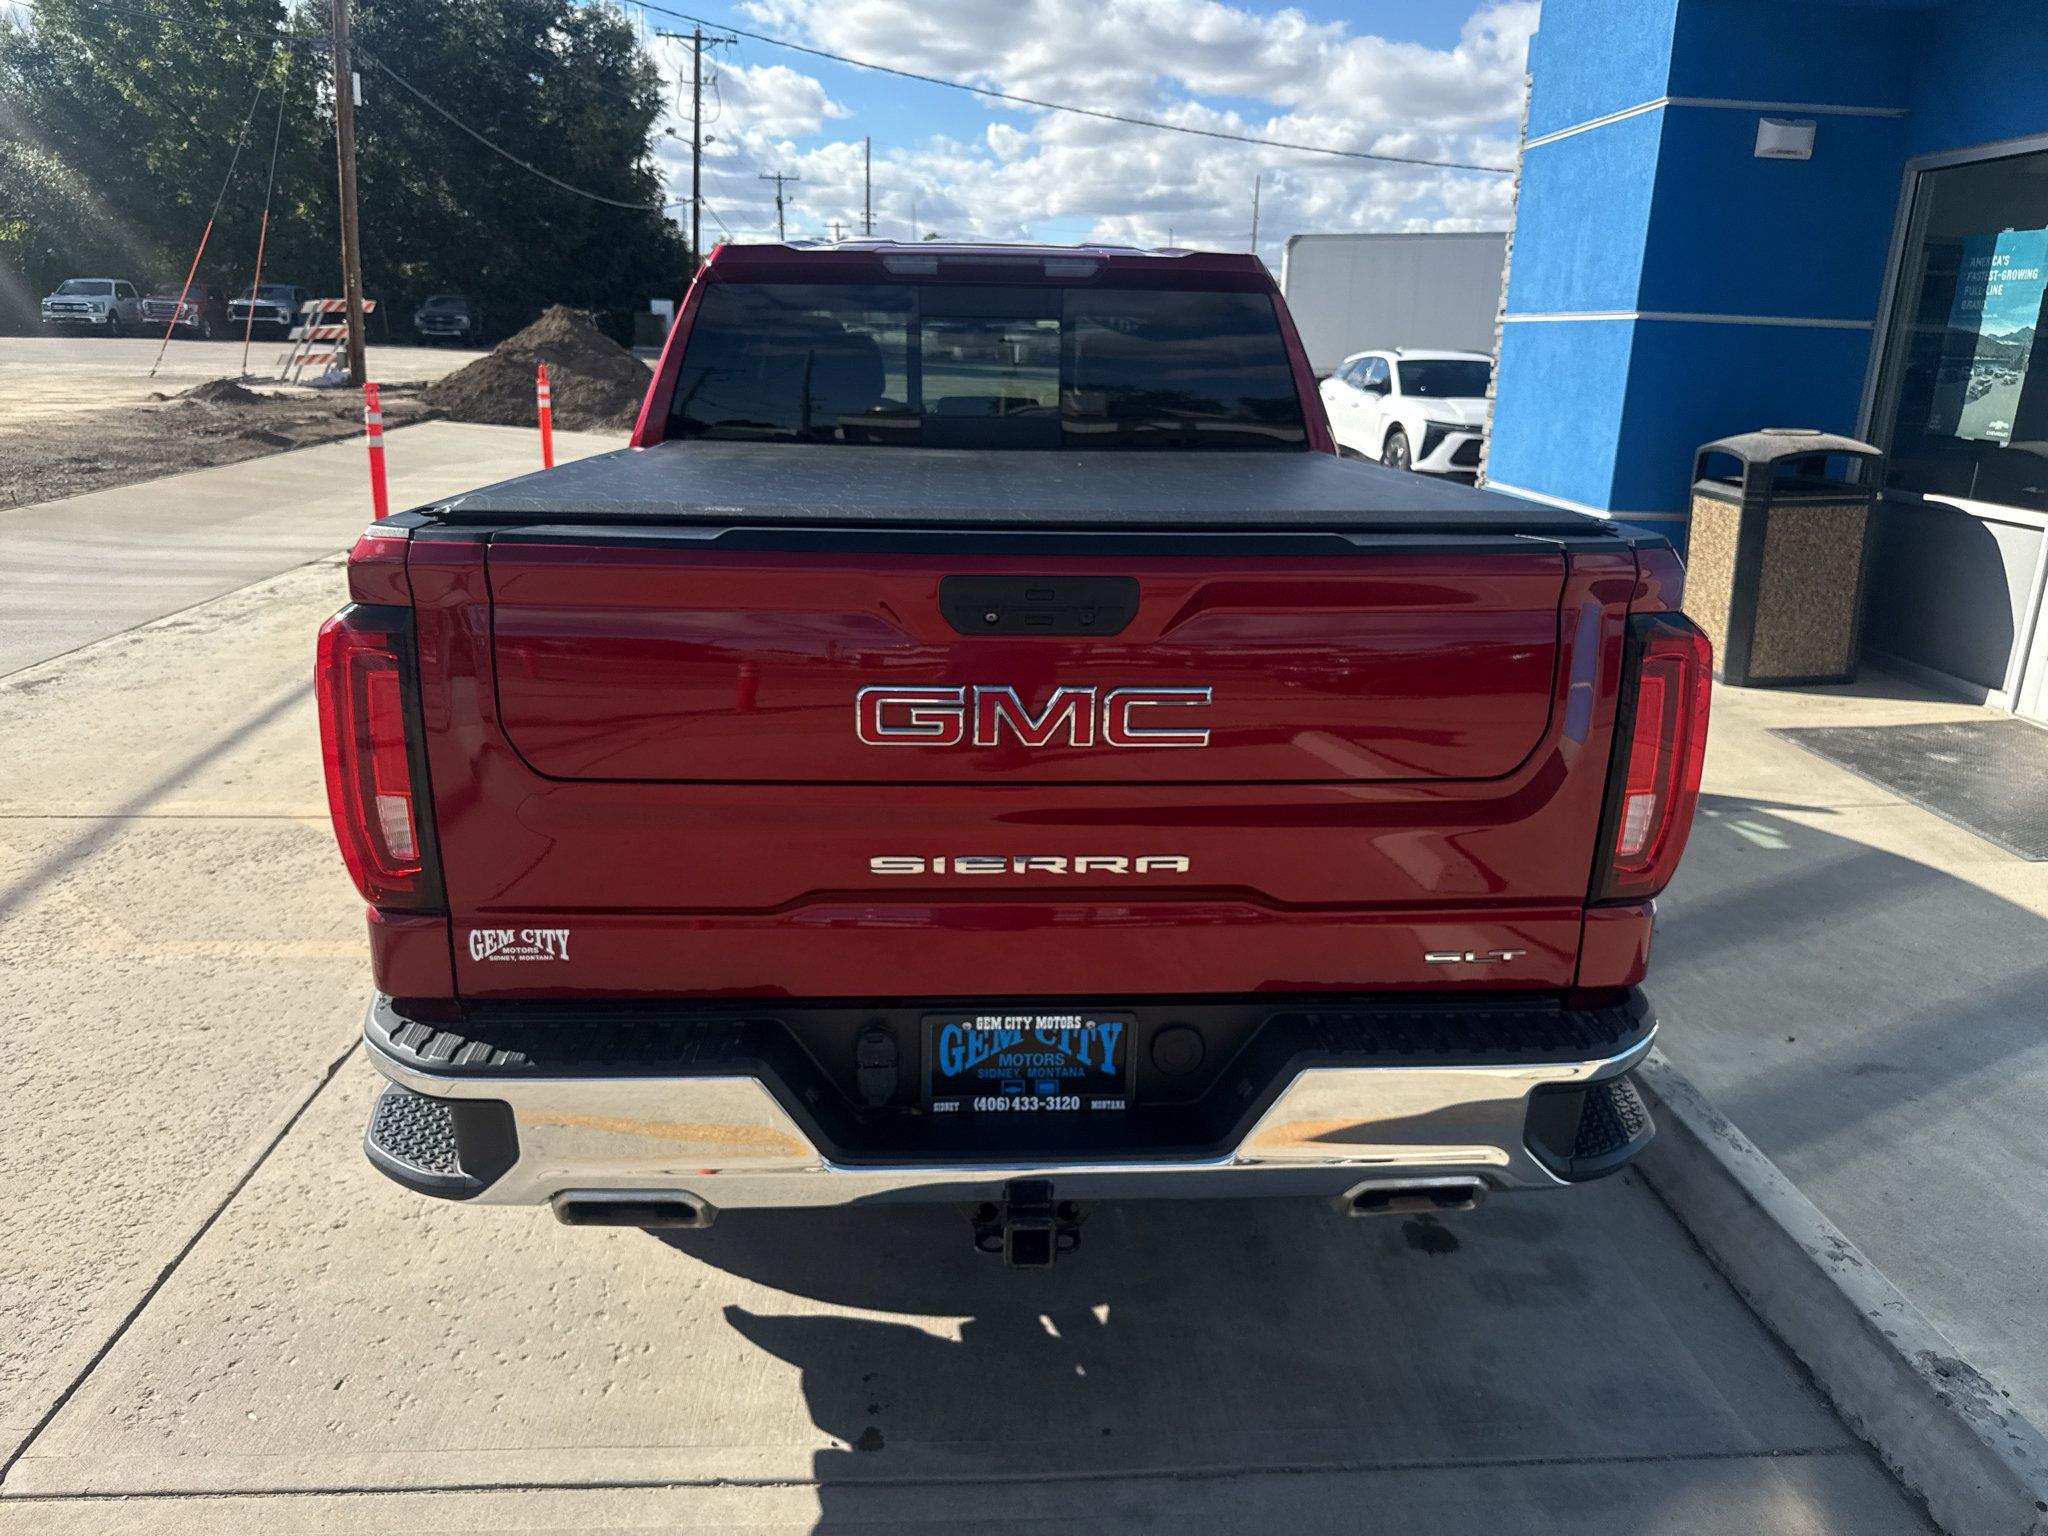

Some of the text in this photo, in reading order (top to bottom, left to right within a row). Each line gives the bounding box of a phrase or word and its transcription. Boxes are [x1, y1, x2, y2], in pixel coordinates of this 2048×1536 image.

[1970, 255, 2010, 267] AMERCA'S
[855, 684, 1213, 748] GMC
[869, 855, 1190, 875] SIERRA
[469, 929, 570, 961] GEM CITY
[502, 946, 539, 954] MOTORS
[1424, 950, 1527, 964] SLT
[976, 1016, 1082, 1030] GEM CITY MOTORS
[939, 1022, 1123, 1077] GEM CITY
[999, 1053, 1065, 1067] MOTORS
[1027, 1066, 1086, 1078] MONTANA
[933, 1101, 960, 1112] SIDNEY
[1091, 1099, 1126, 1110] MONTANA
